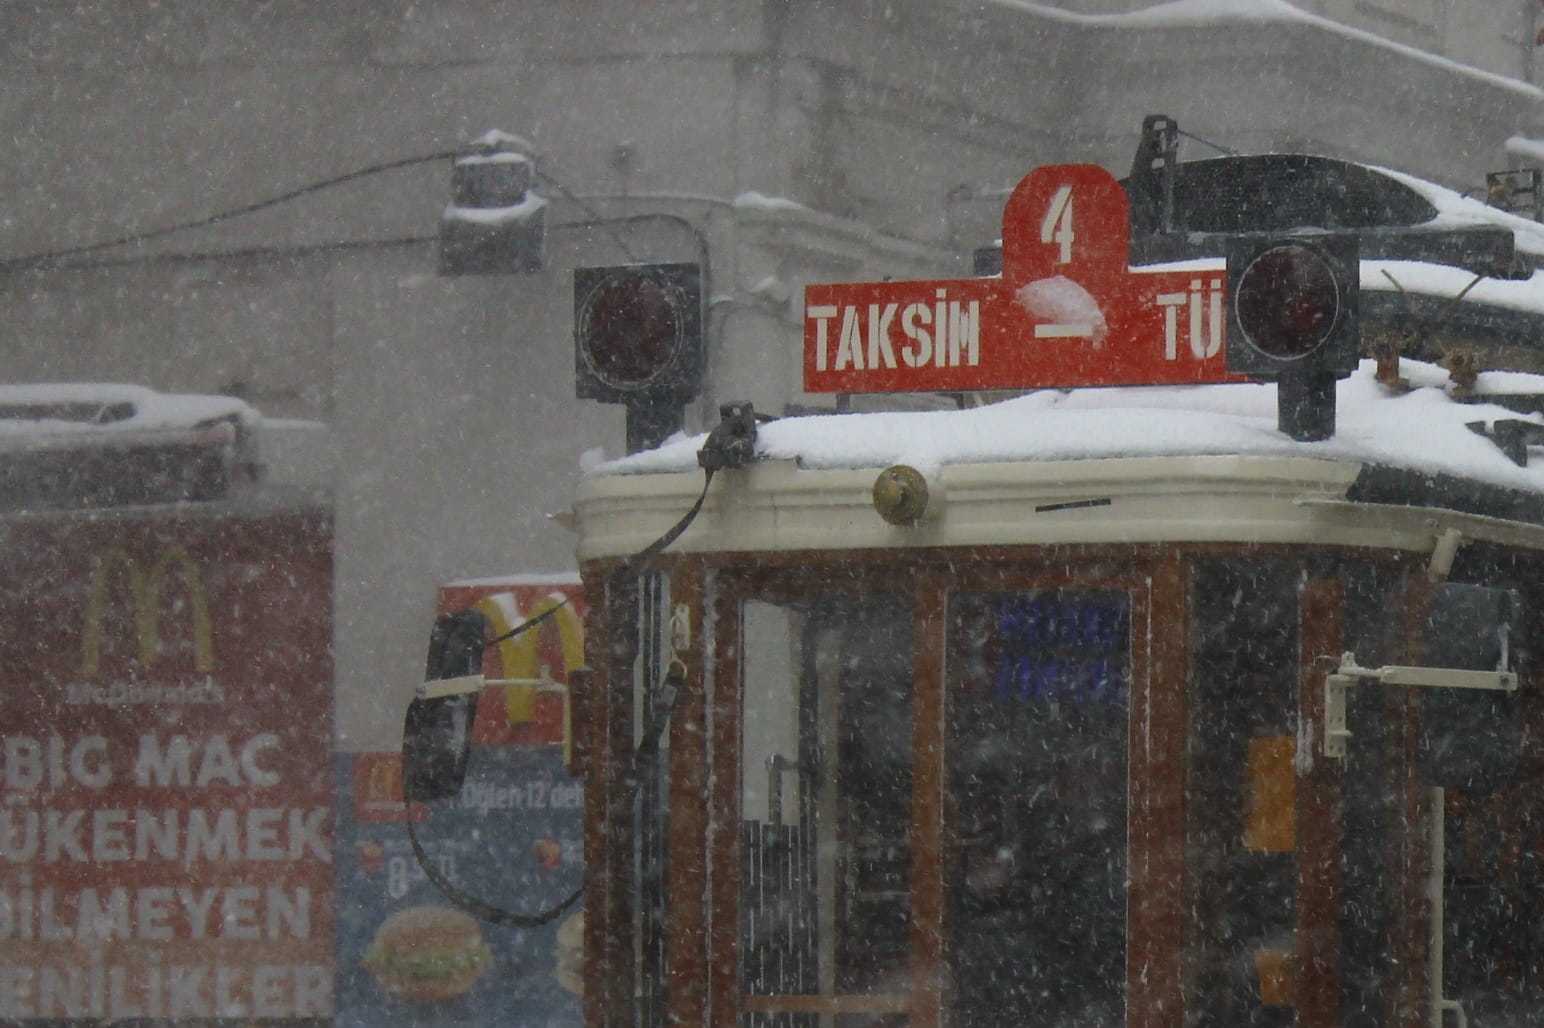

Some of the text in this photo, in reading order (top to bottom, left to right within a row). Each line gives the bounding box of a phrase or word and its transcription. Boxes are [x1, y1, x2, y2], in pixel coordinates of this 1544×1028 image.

[1041, 186, 1075, 264] 4
[808, 279, 1222, 371] TAKSİM TÜ
[135, 735, 281, 788] MAC
